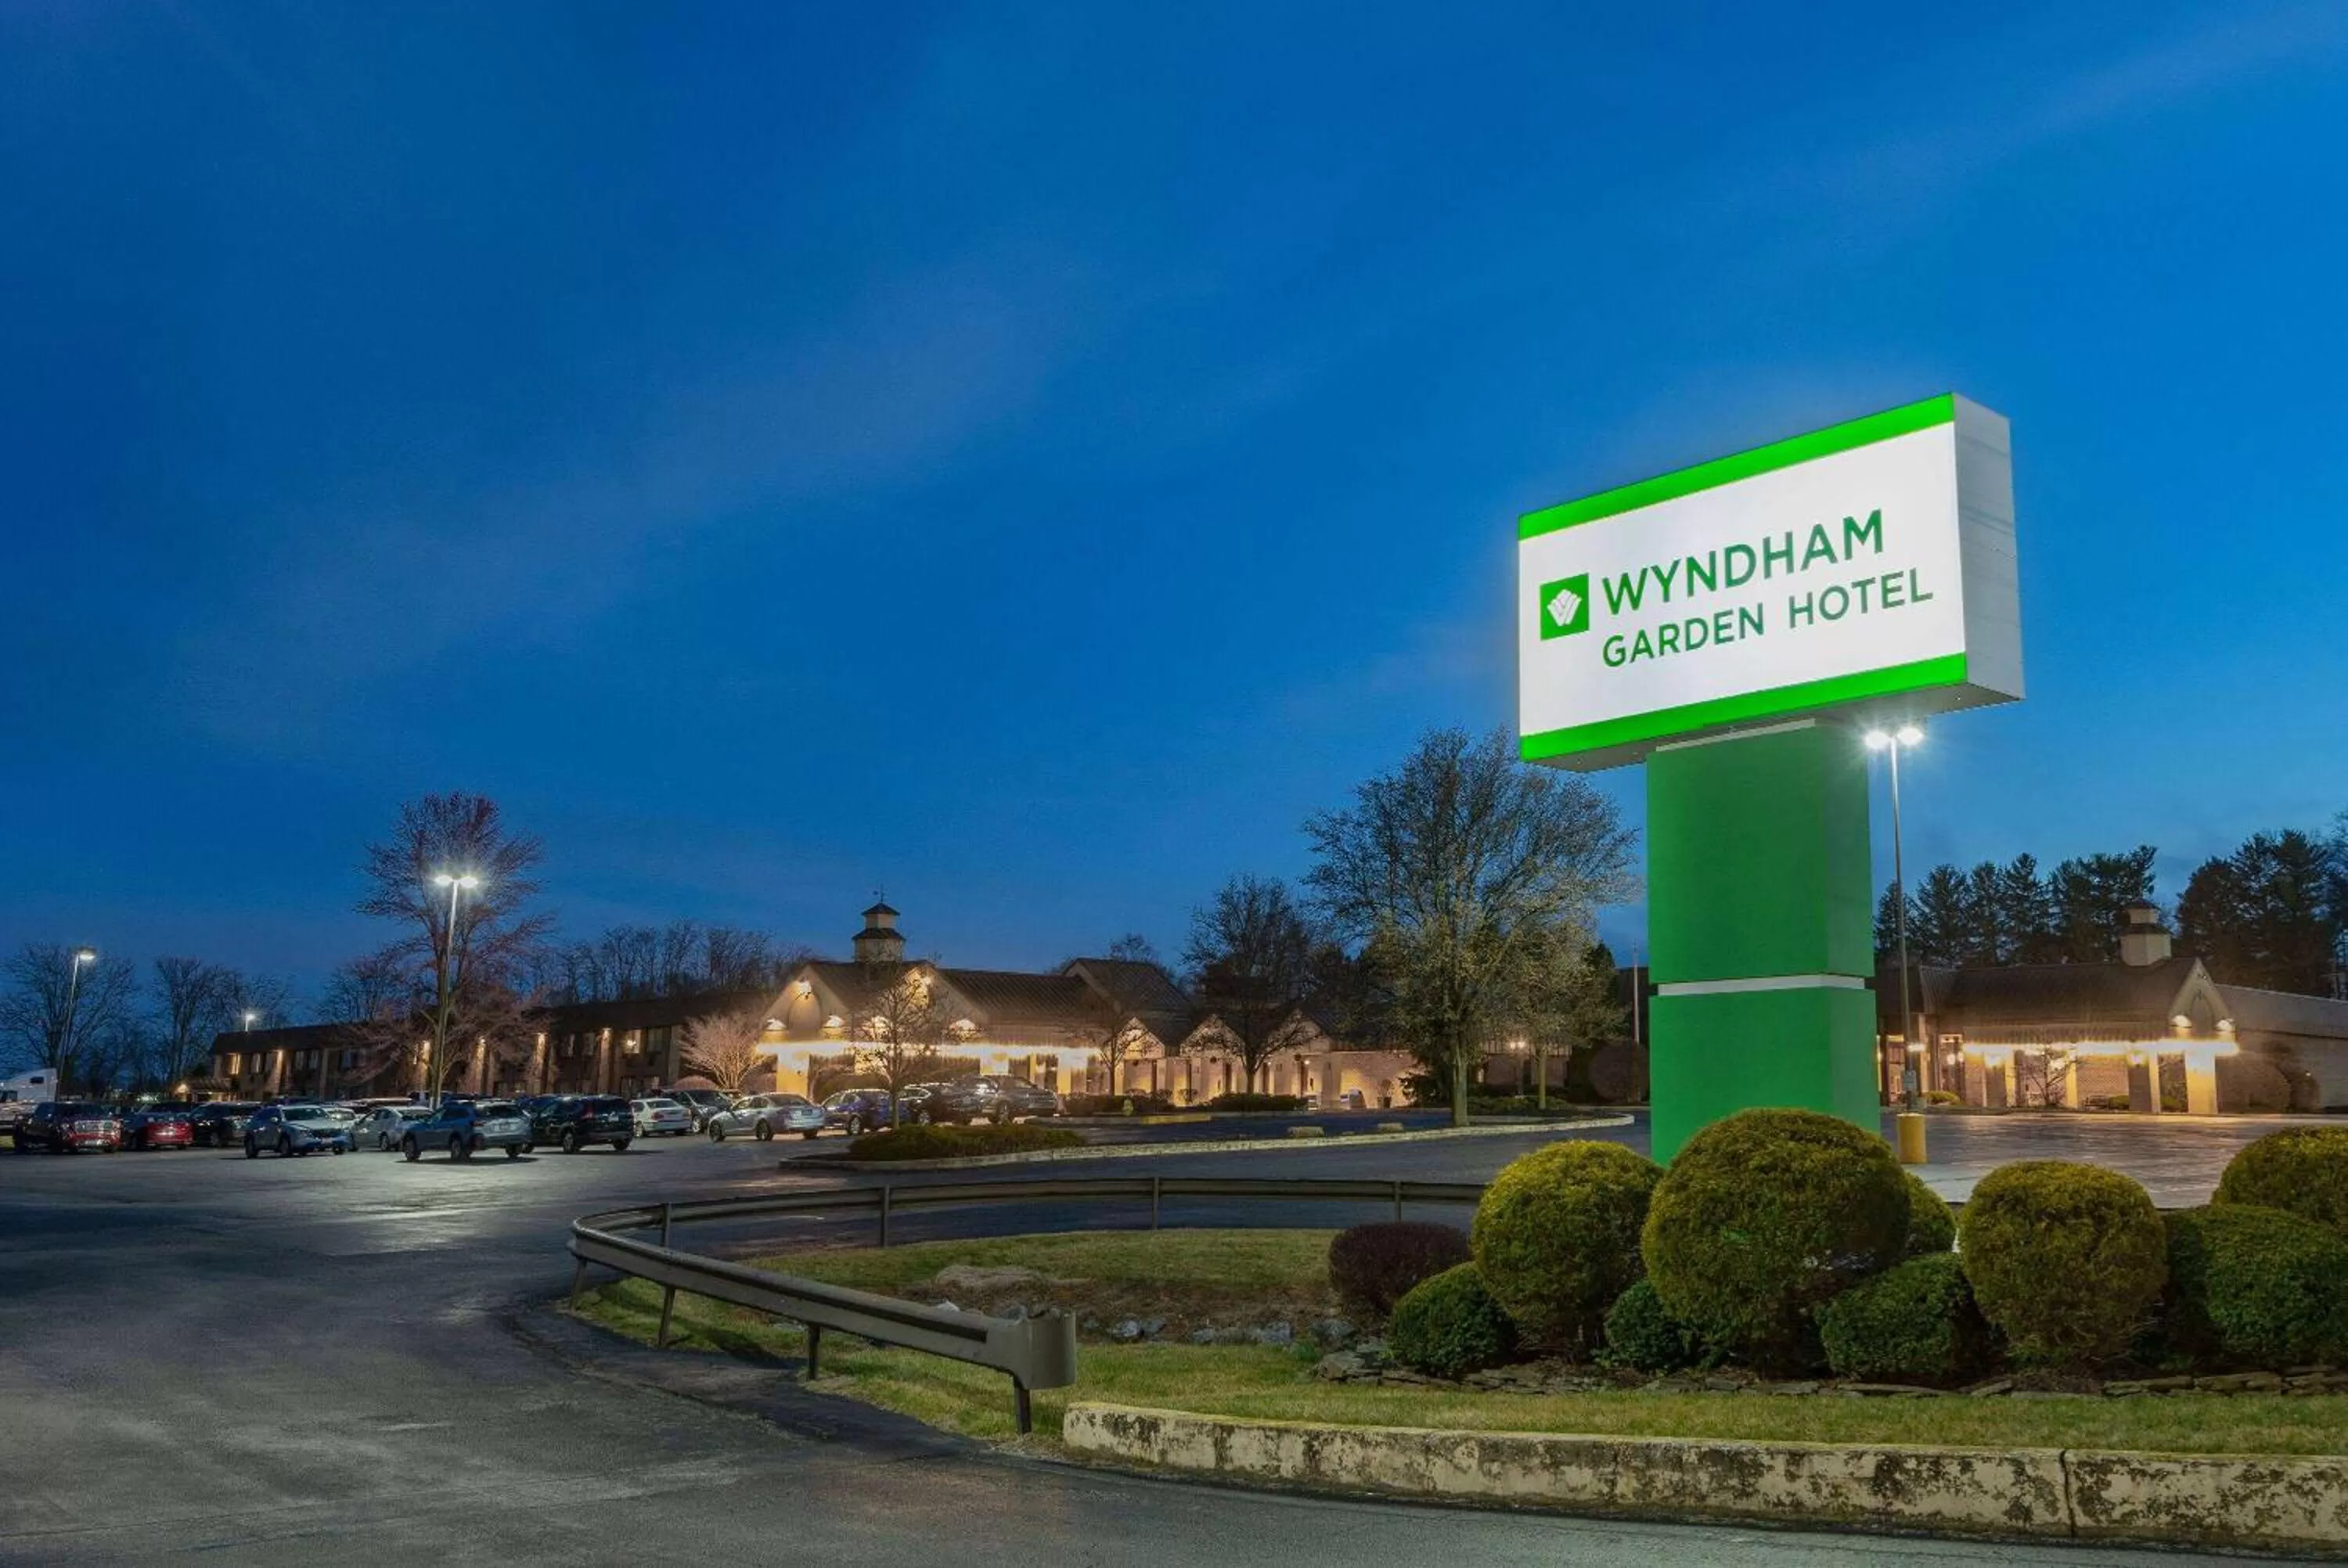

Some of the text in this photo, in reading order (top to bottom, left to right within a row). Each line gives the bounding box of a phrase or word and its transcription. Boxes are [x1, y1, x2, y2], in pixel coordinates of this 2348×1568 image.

[1602, 509, 1883, 615] WYNDHAM
[1602, 568, 1933, 667] GARDEN HOTEL
